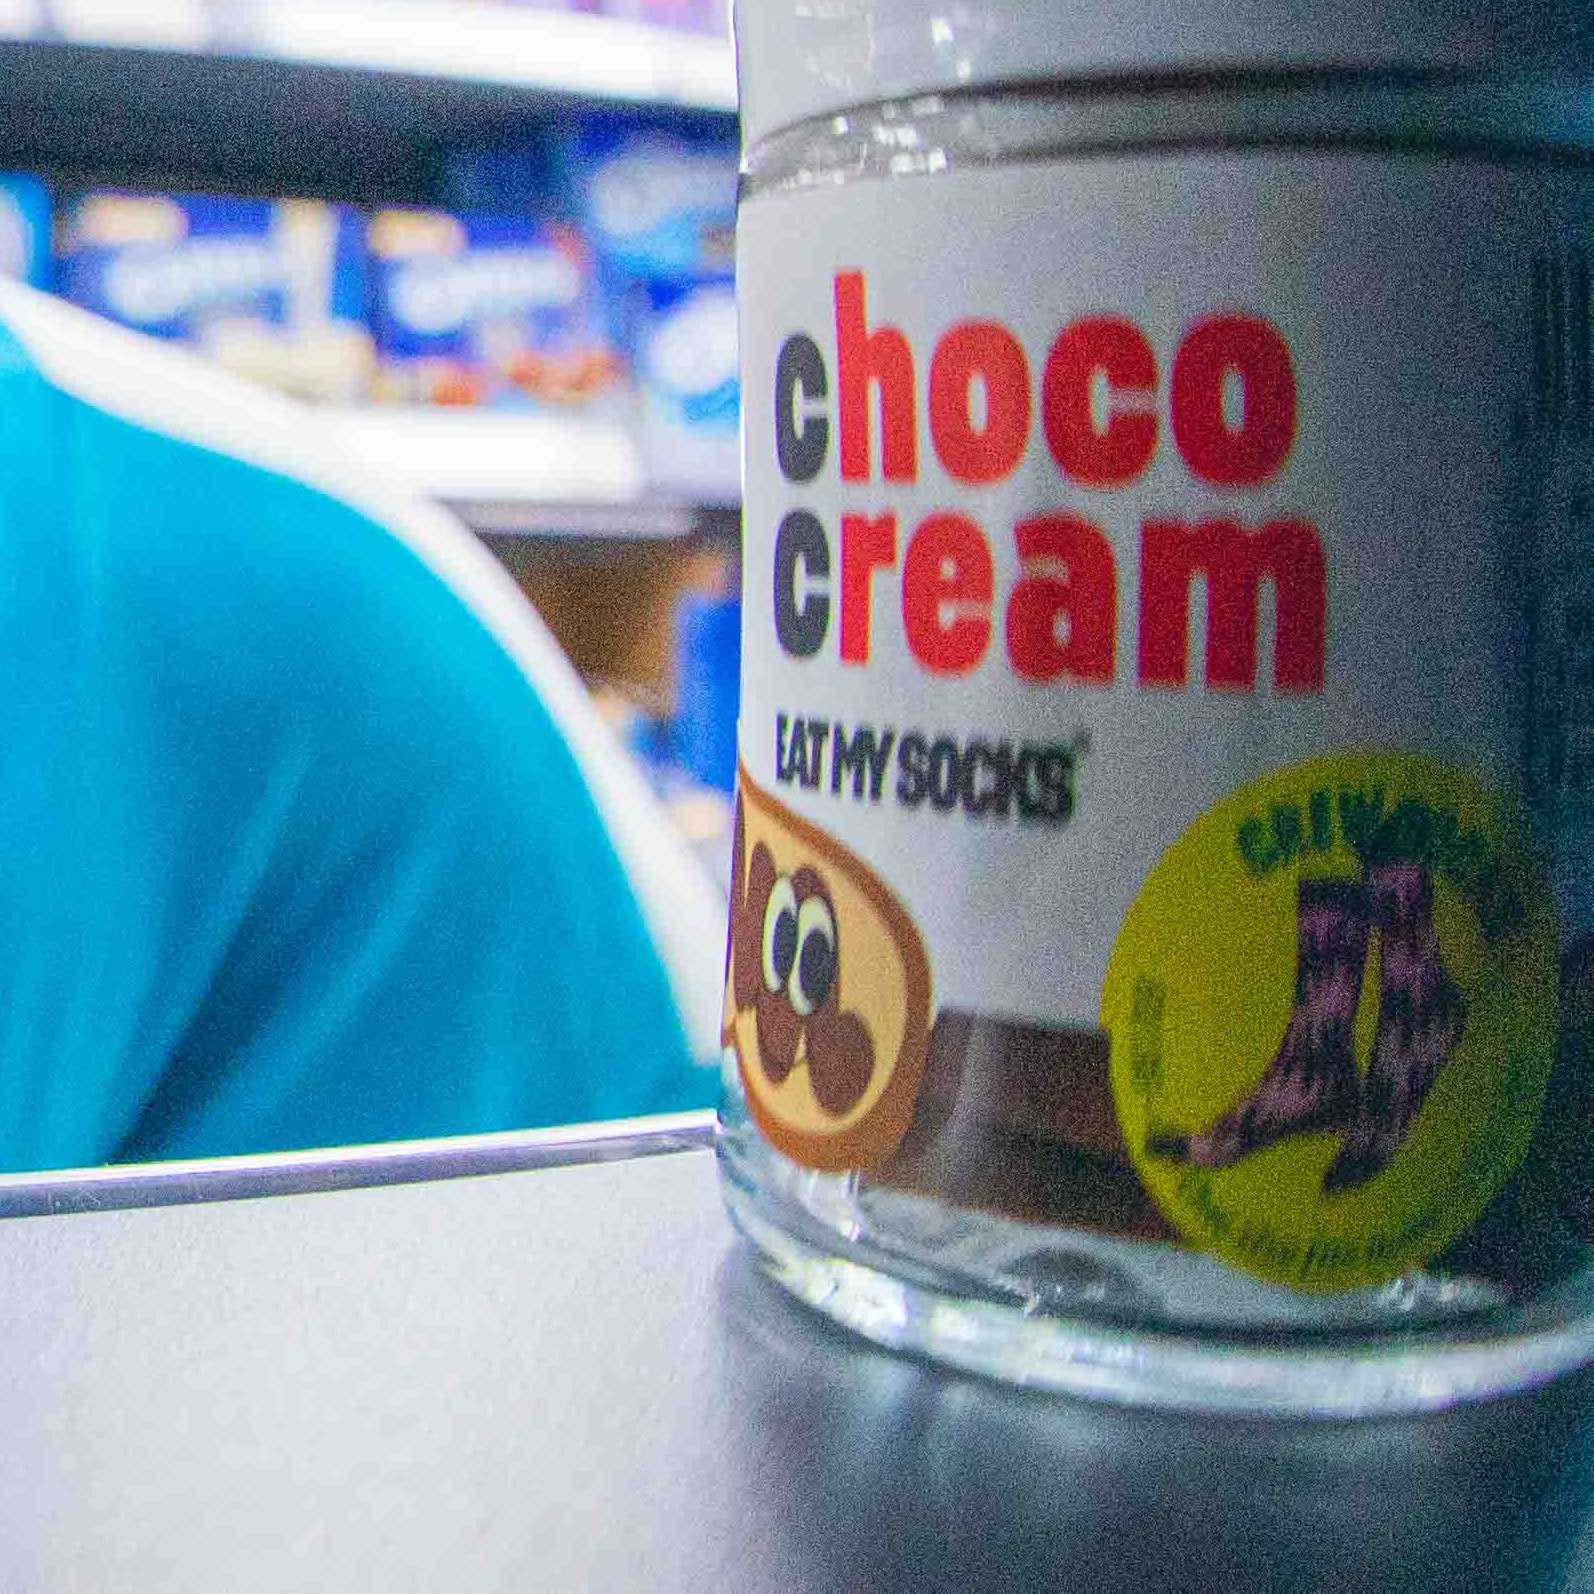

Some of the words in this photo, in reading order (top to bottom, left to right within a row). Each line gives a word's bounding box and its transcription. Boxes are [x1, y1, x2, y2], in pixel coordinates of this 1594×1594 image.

[773, 269, 1298, 488] choco
[772, 506, 1327, 696] cream
[774, 709, 828, 791] EAT
[829, 720, 894, 804] MY
[896, 731, 1076, 834] SOCKS
